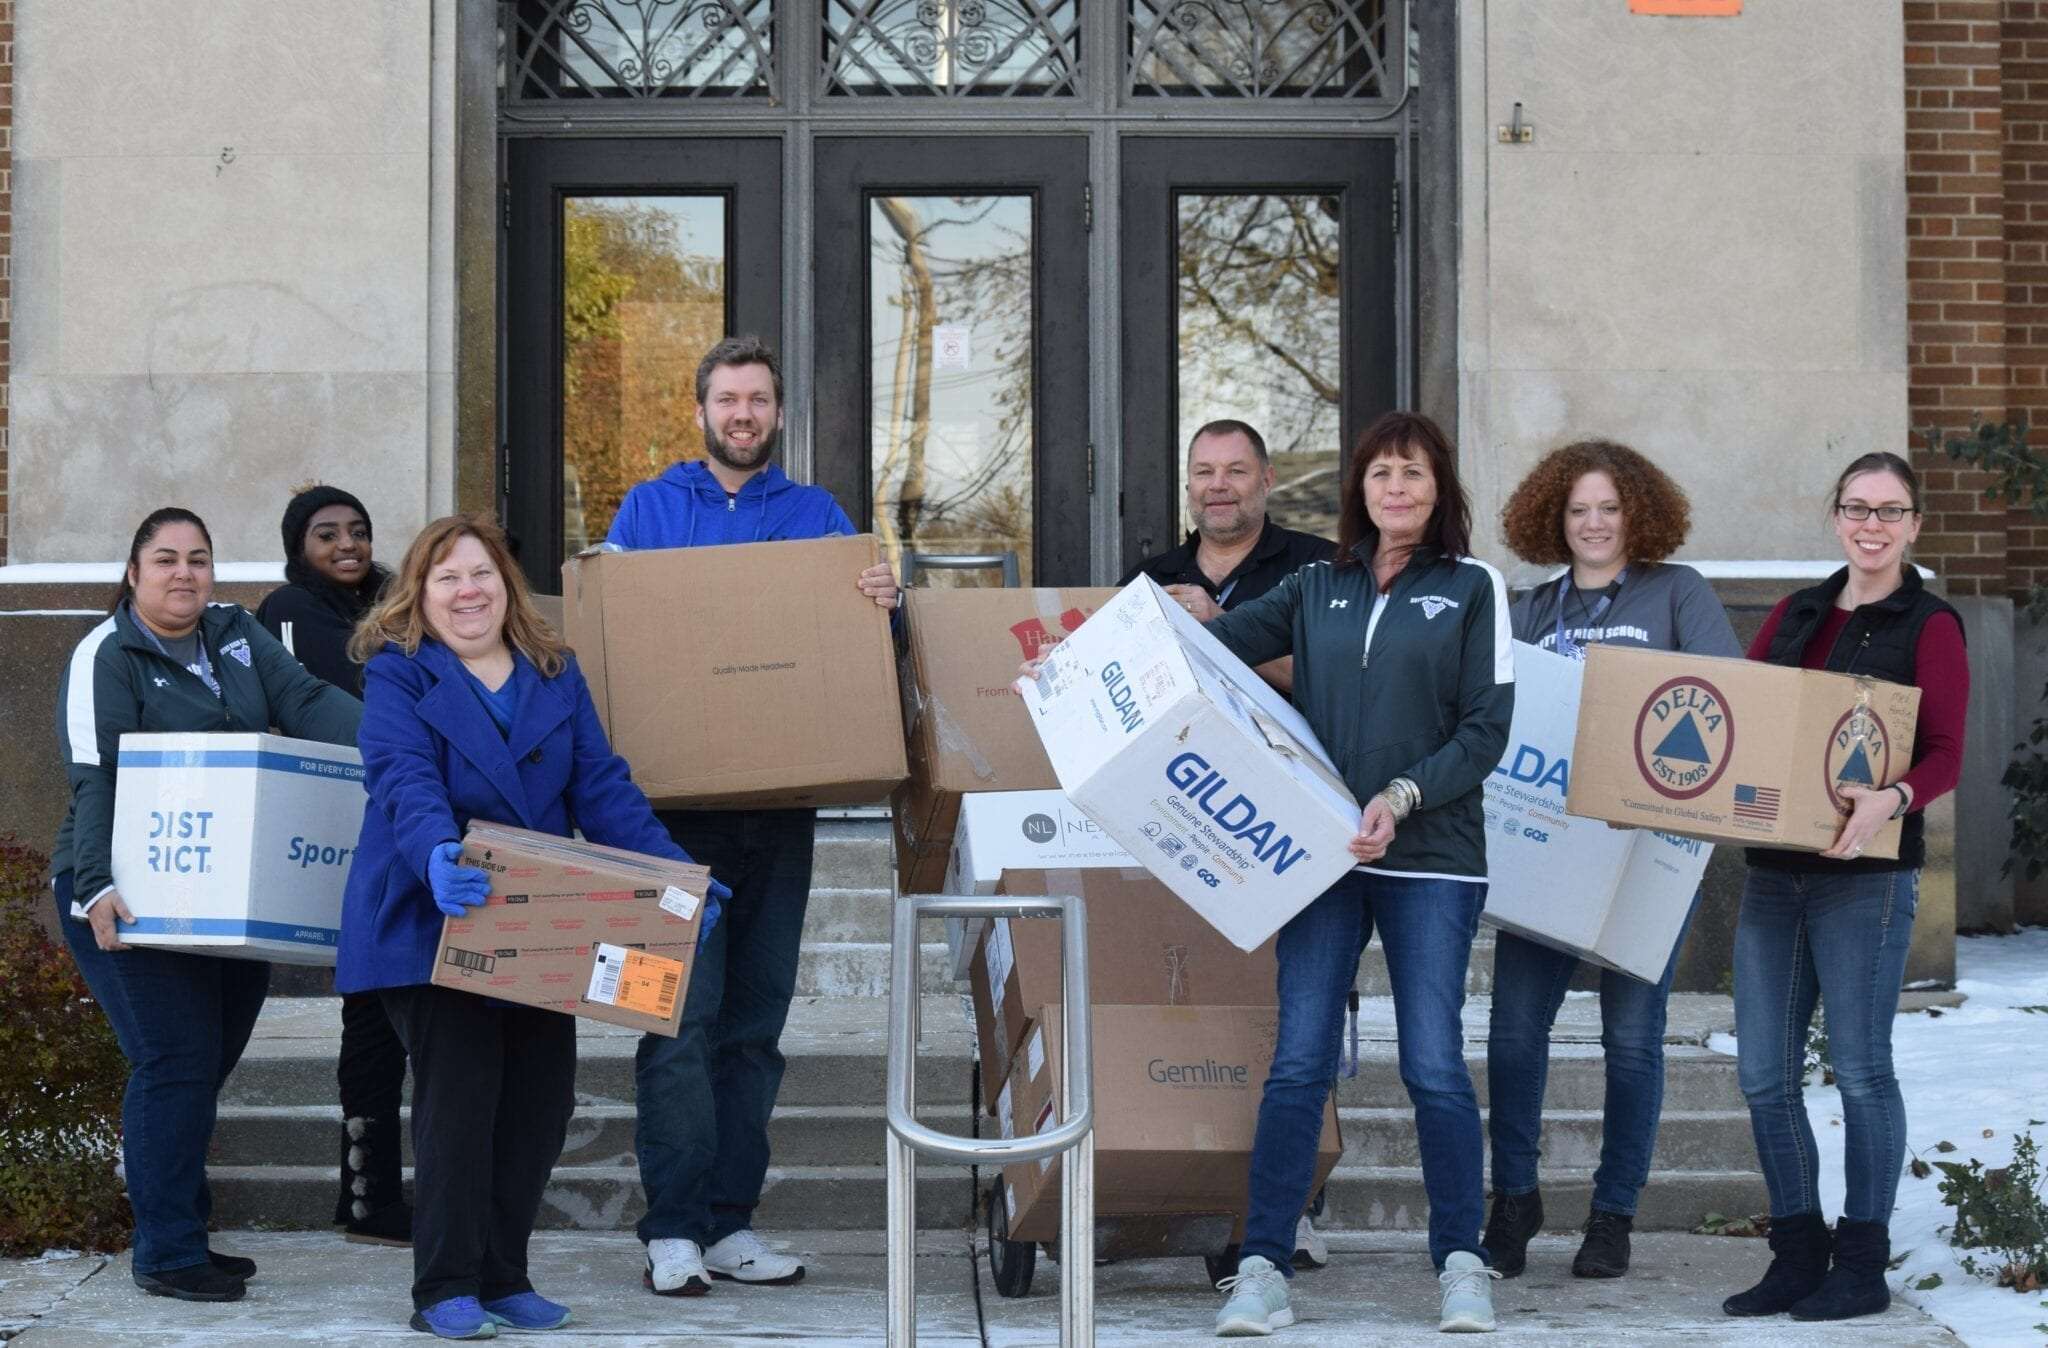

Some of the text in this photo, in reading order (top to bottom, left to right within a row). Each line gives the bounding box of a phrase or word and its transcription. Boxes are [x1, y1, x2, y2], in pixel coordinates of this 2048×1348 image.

[1605, 625, 1649, 642] SCHOOL
[976, 687, 1009, 697] From
[1101, 661, 1144, 734] GILDAN
[1652, 687, 1723, 733] DELTA
[1836, 718, 1882, 757] DELTA
[300, 760, 317, 772] FOR
[318, 763, 343, 774] EVERY
[1166, 752, 1307, 876] GILDAN
[1167, 795, 1249, 870] Genuine Stewardship
[480, 861, 497, 872] SIDE
[497, 864, 507, 873] UP
[294, 929, 325, 941] APPAREL
[1148, 1059, 1247, 1083] Gemline
